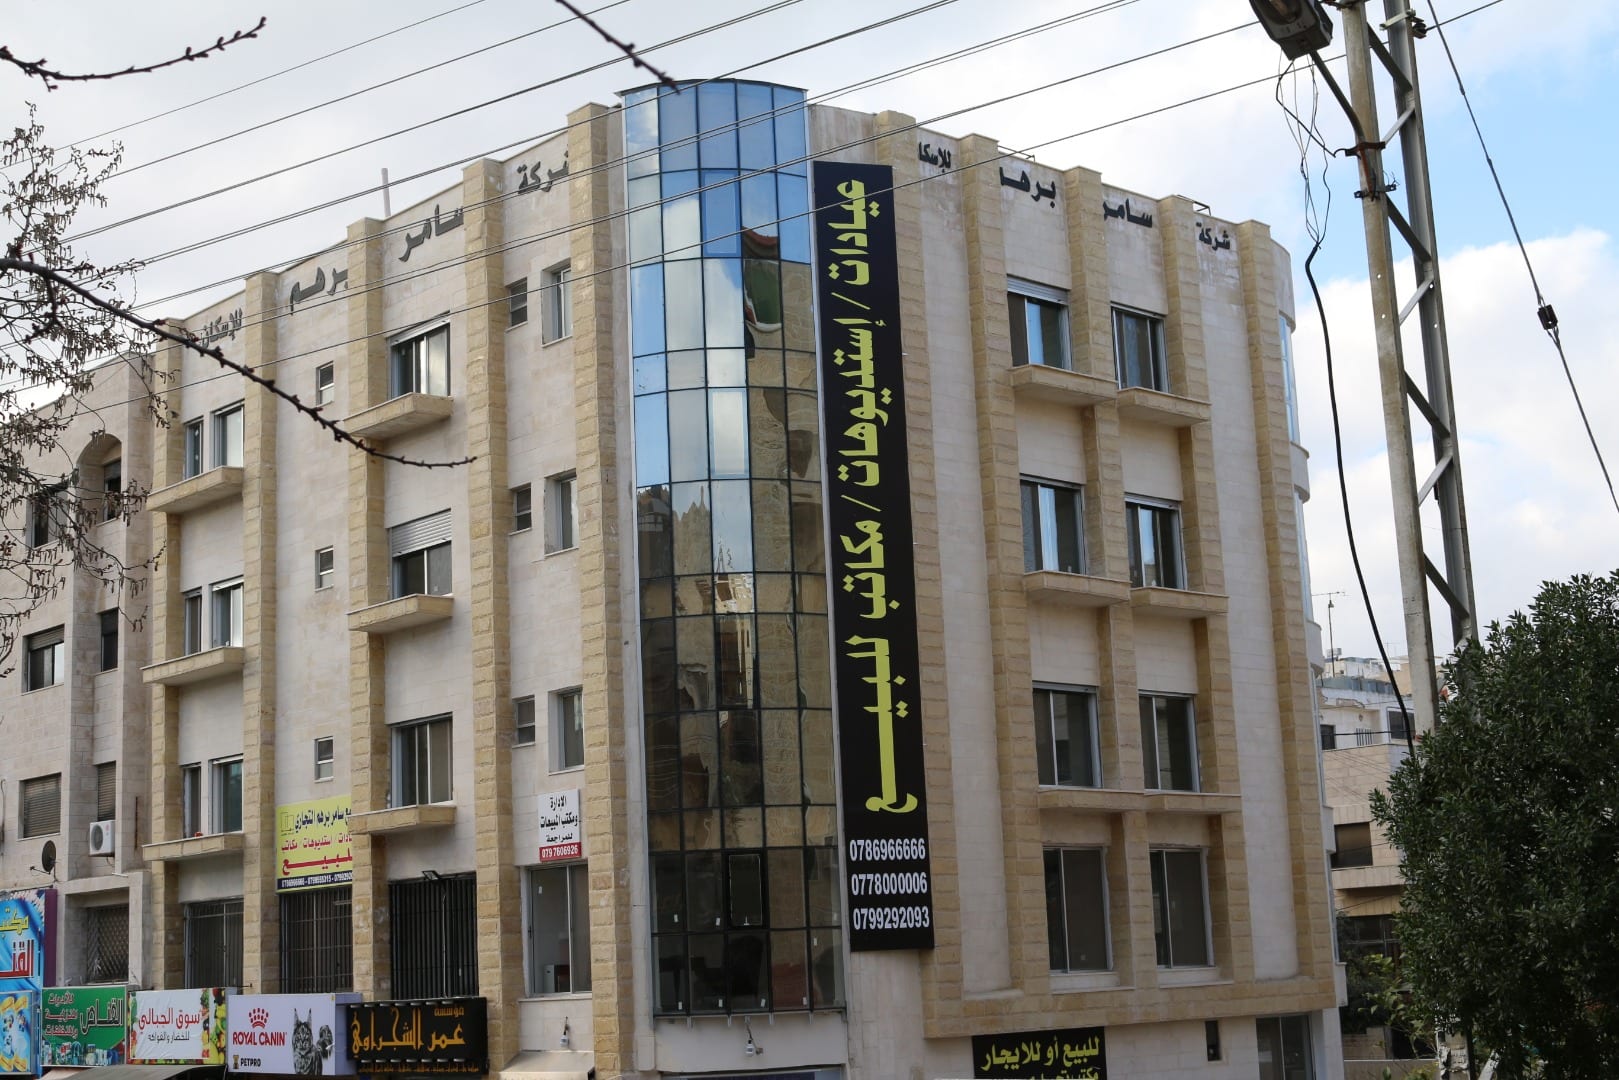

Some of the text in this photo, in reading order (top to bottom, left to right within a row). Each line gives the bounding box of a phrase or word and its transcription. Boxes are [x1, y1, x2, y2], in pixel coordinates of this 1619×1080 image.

[827, 179, 881, 286] عيادات
[1195, 222, 1231, 251] شركة
[840, 520, 900, 619] مكاتب
[845, 635, 918, 813] للبيع
[849, 838, 926, 862] 0786966666
[851, 872, 928, 896] 0778000006
[853, 905, 930, 930] 0799292093
[138, 1007, 200, 1034] سوق الجبالي
[232, 1031, 257, 1046] ROYAL
[427, 1023, 465, 1052] عمر
[1062, 1036, 1099, 1067] للبيع
[240, 1057, 261, 1067] PETPRO
